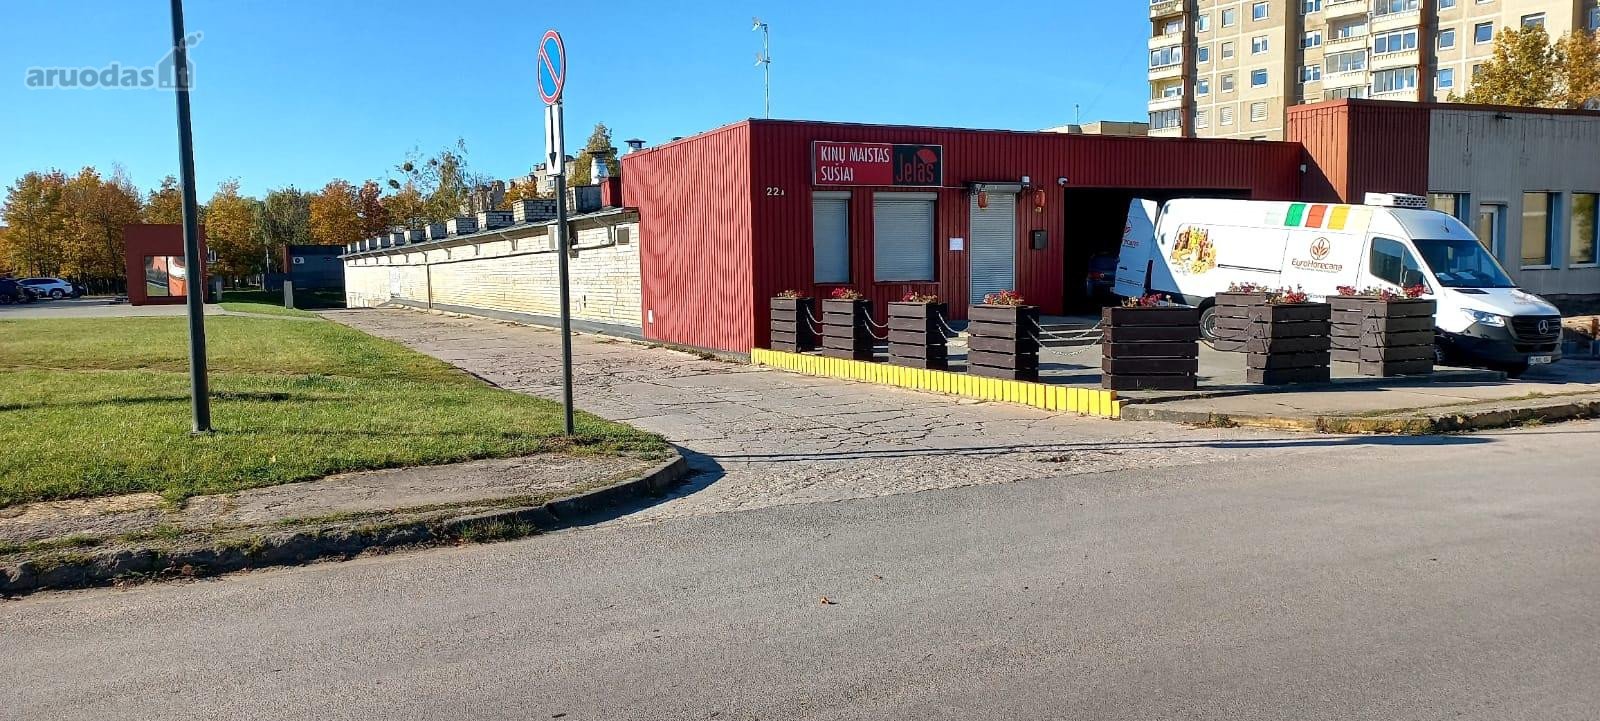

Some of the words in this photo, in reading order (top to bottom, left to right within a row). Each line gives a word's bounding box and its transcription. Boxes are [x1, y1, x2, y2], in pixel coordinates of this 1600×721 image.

[821, 146, 845, 164] KINŲ
[849, 147, 890, 163] MAISTAS
[821, 163, 853, 182] SUŠIAI
[896, 154, 934, 183] Jelas
